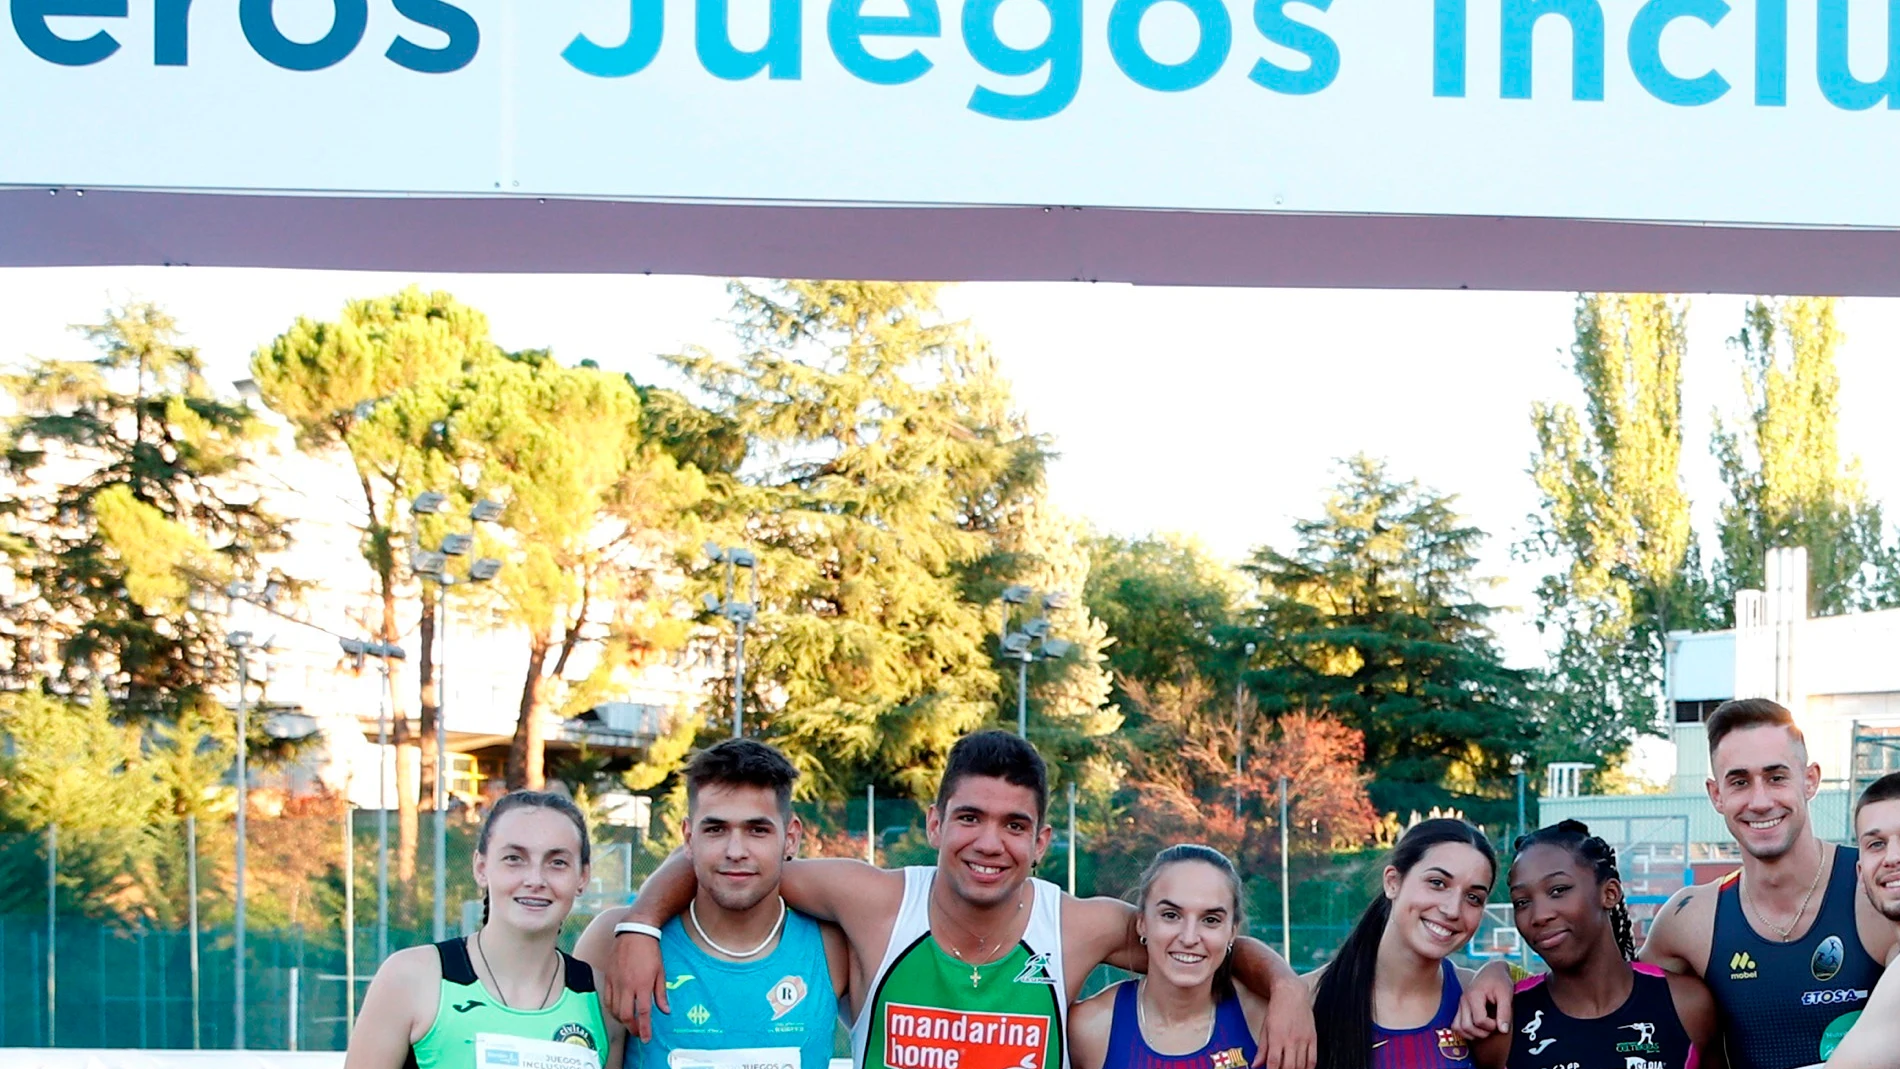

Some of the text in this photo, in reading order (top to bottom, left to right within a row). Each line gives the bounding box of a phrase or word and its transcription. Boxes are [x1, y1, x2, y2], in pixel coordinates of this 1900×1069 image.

[10, 0, 479, 73] eros
[561, 0, 1340, 120] Juegos
[1731, 971, 1757, 980] mobel
[781, 987, 793, 1001] R
[1801, 990, 1858, 1005] ETOSA
[891, 1013, 1041, 1047] mandarina
[546, 1054, 582, 1066] JUEGOS
[891, 1038, 960, 1069] home
